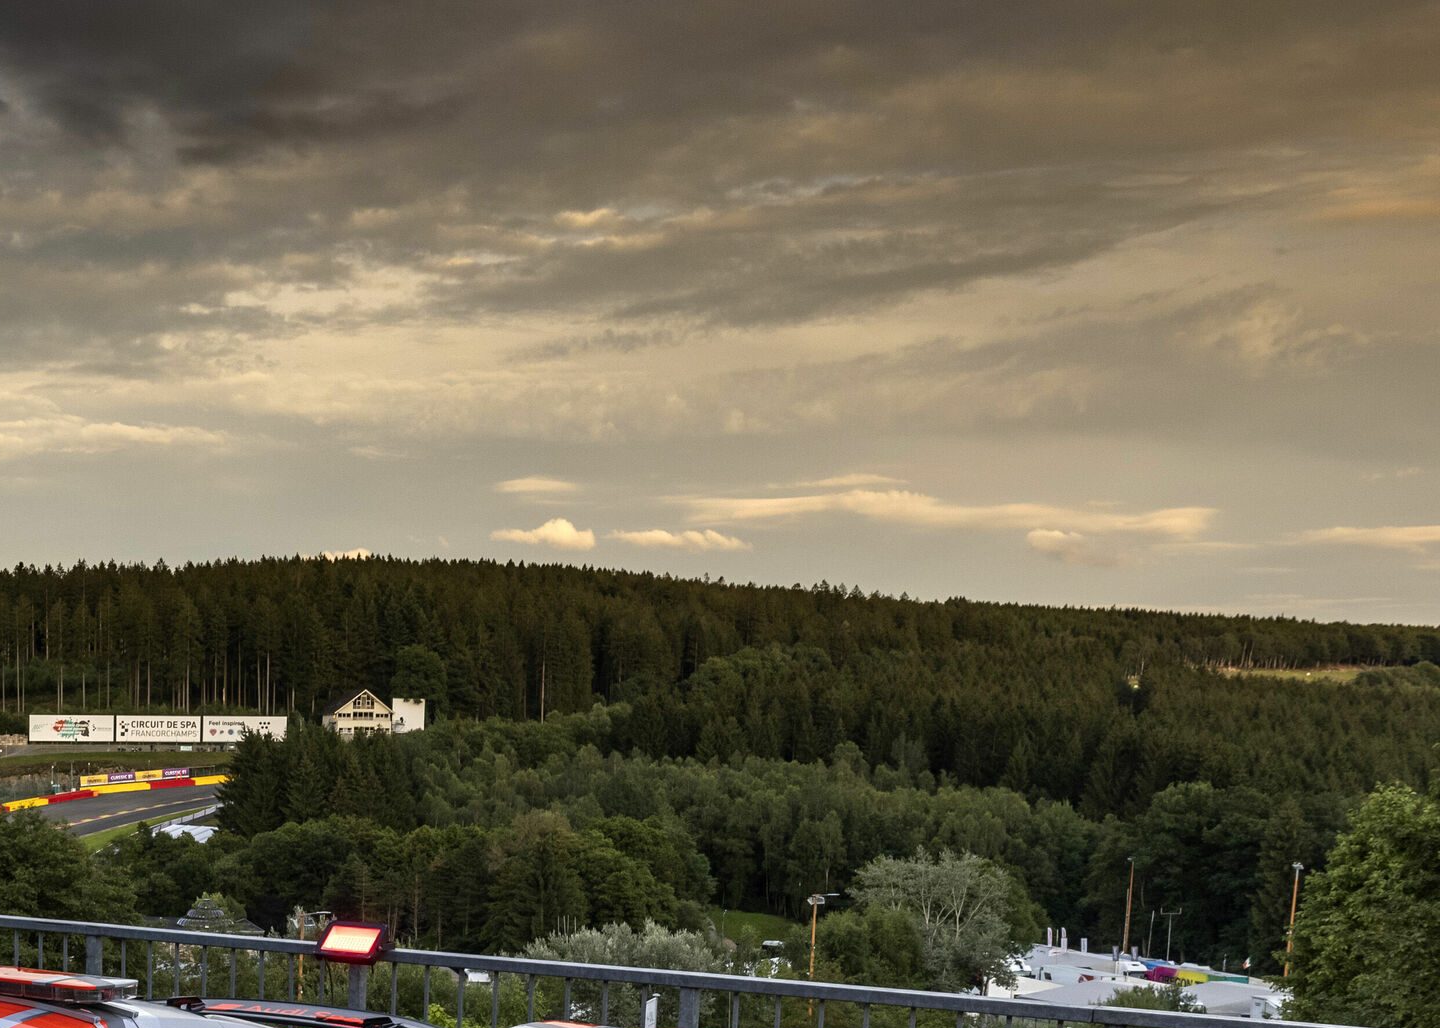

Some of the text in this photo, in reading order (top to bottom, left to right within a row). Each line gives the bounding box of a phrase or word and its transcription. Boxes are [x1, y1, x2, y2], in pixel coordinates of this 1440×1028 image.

[131, 720, 197, 729] CIRCUIT DE SPA
